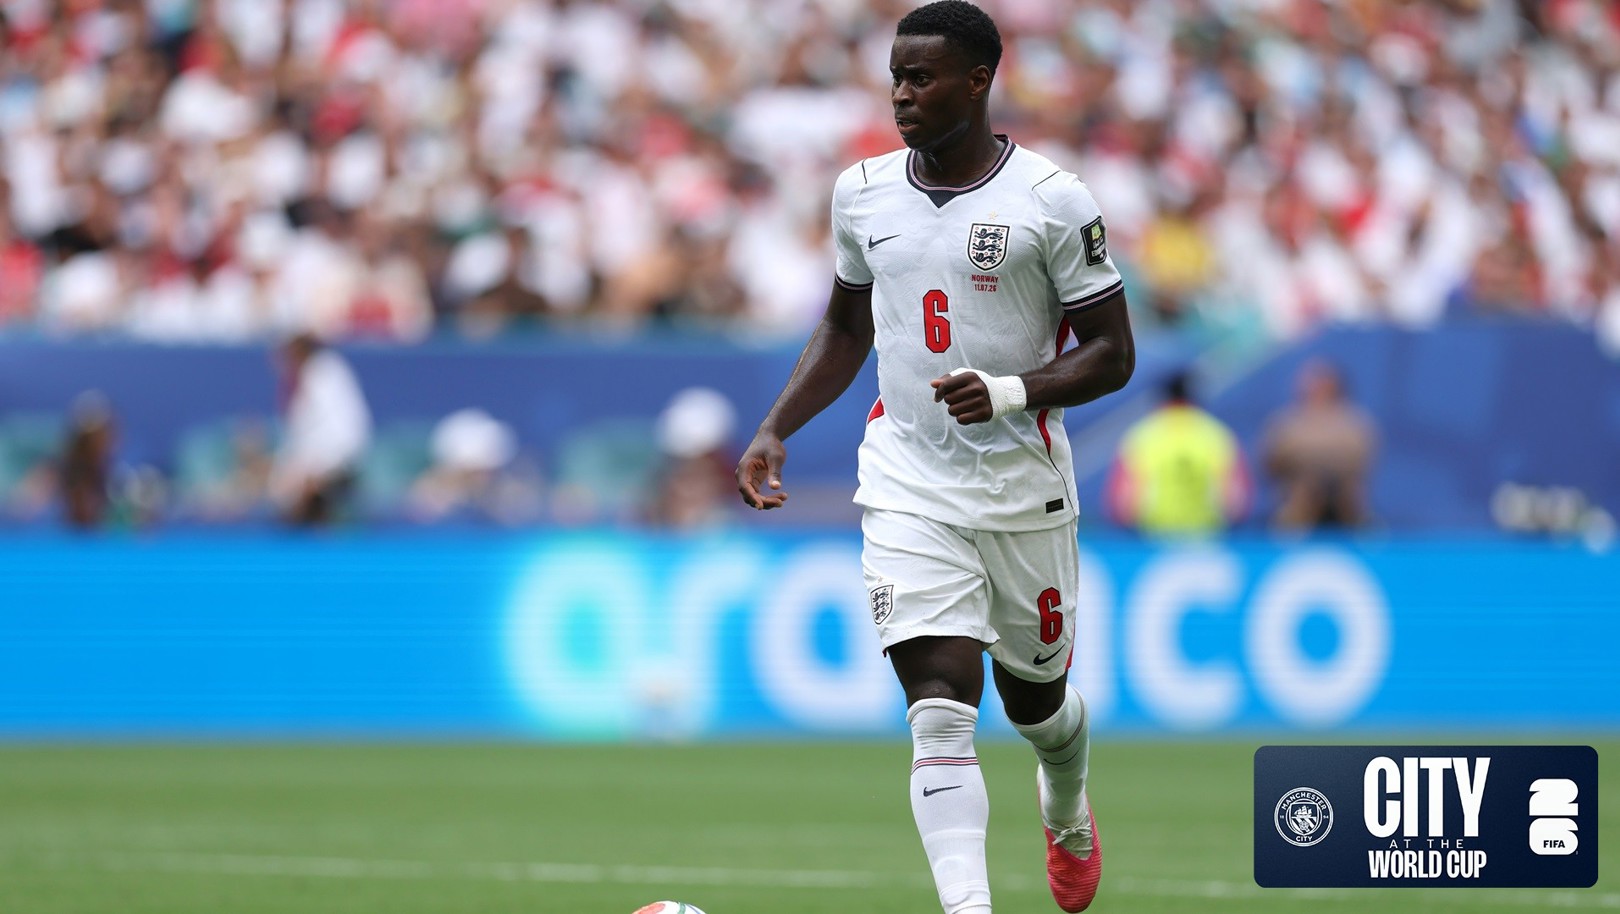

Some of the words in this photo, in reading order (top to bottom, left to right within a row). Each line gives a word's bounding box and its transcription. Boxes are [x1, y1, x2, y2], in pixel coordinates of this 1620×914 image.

[971, 274, 998, 283] NORWAY
[923, 289, 951, 353] 6
[504, 543, 1391, 732] araco
[1037, 587, 1063, 645] 6
